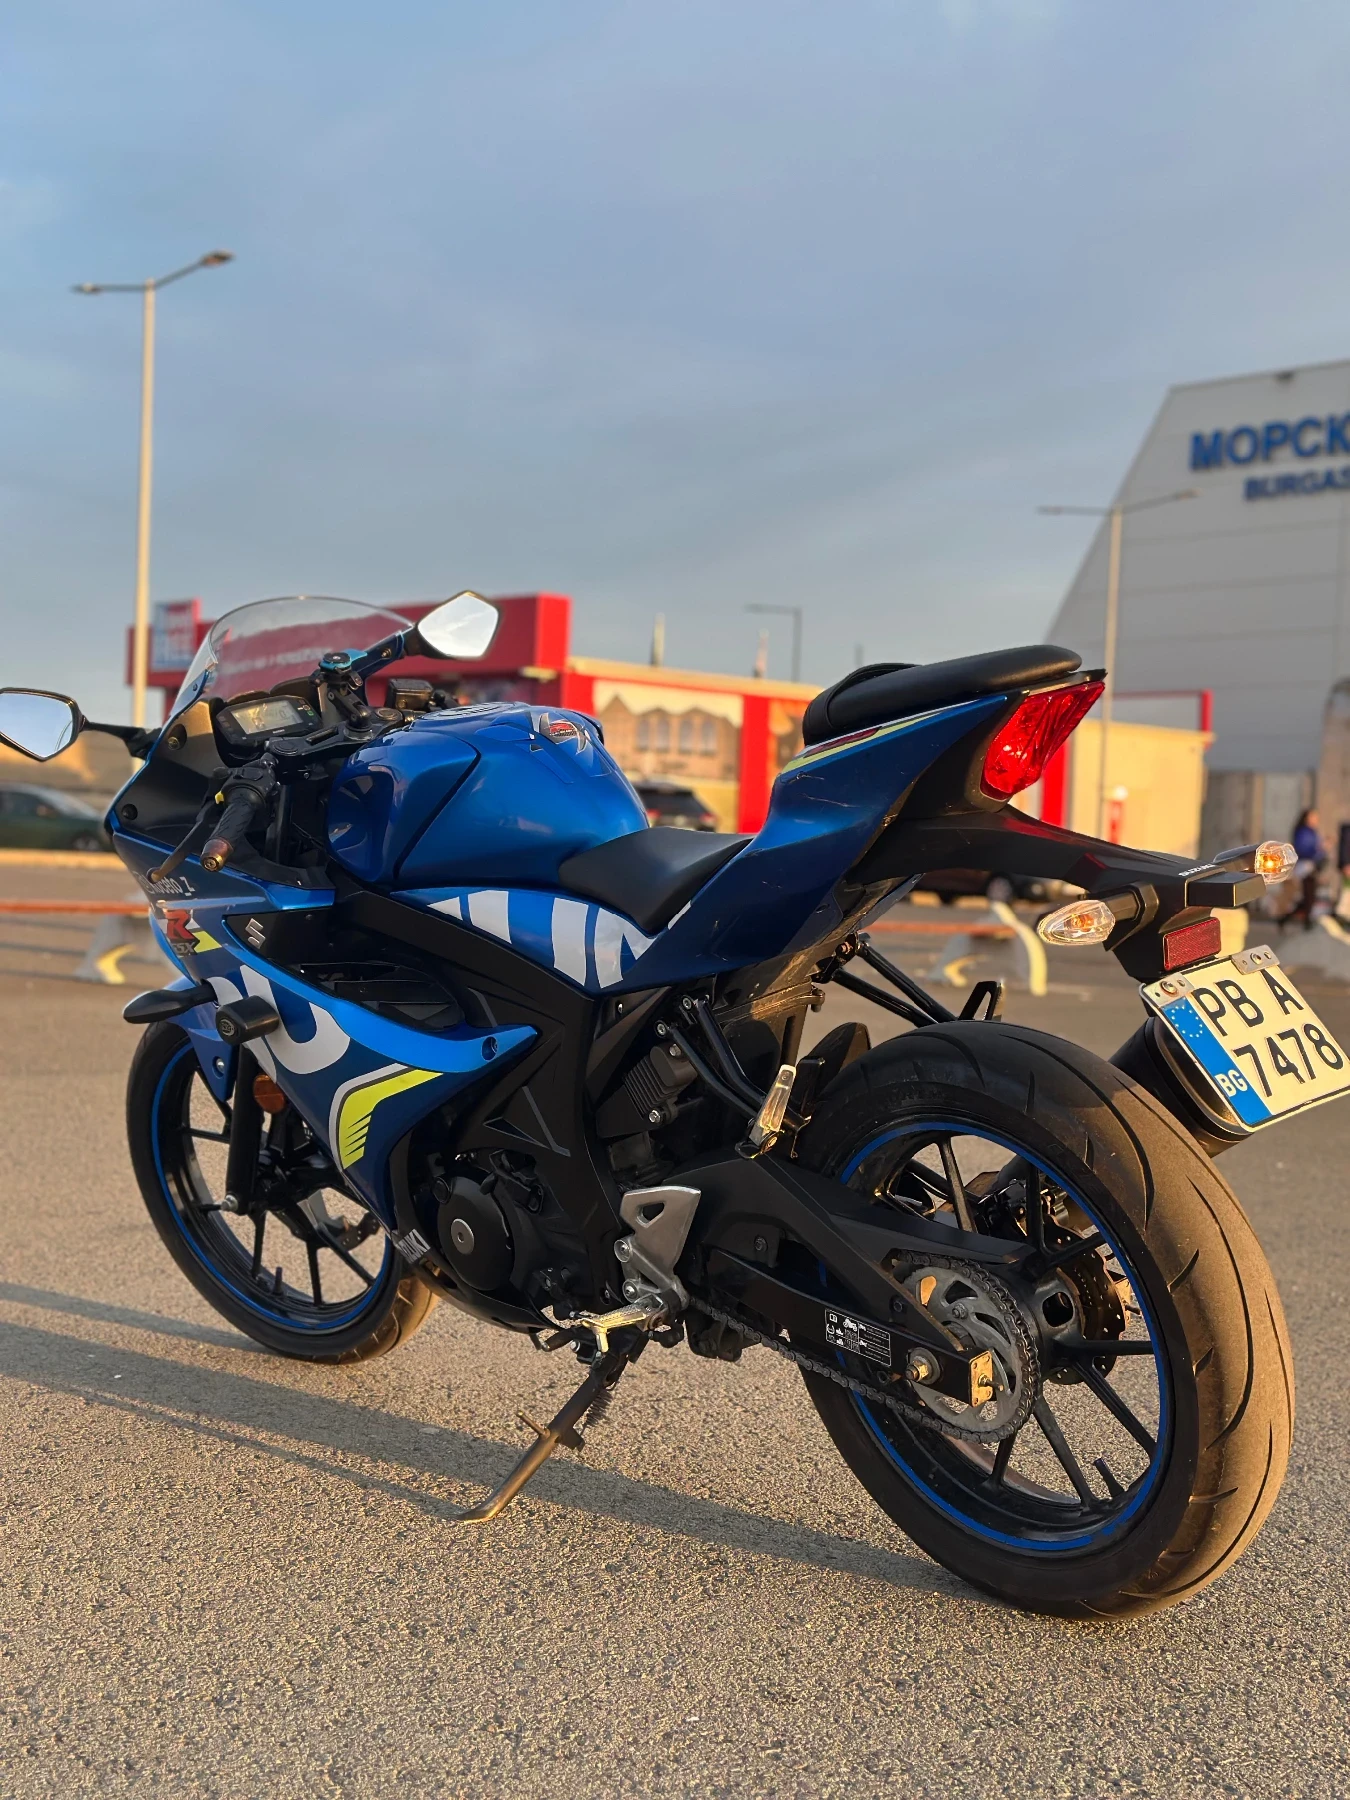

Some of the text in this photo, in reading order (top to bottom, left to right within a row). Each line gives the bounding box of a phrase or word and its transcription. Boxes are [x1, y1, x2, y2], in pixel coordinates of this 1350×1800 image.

[1190, 968, 1305, 1037] PB A
[1215, 1069, 1248, 1098] BG
[1232, 1023, 1344, 1098] 7478
